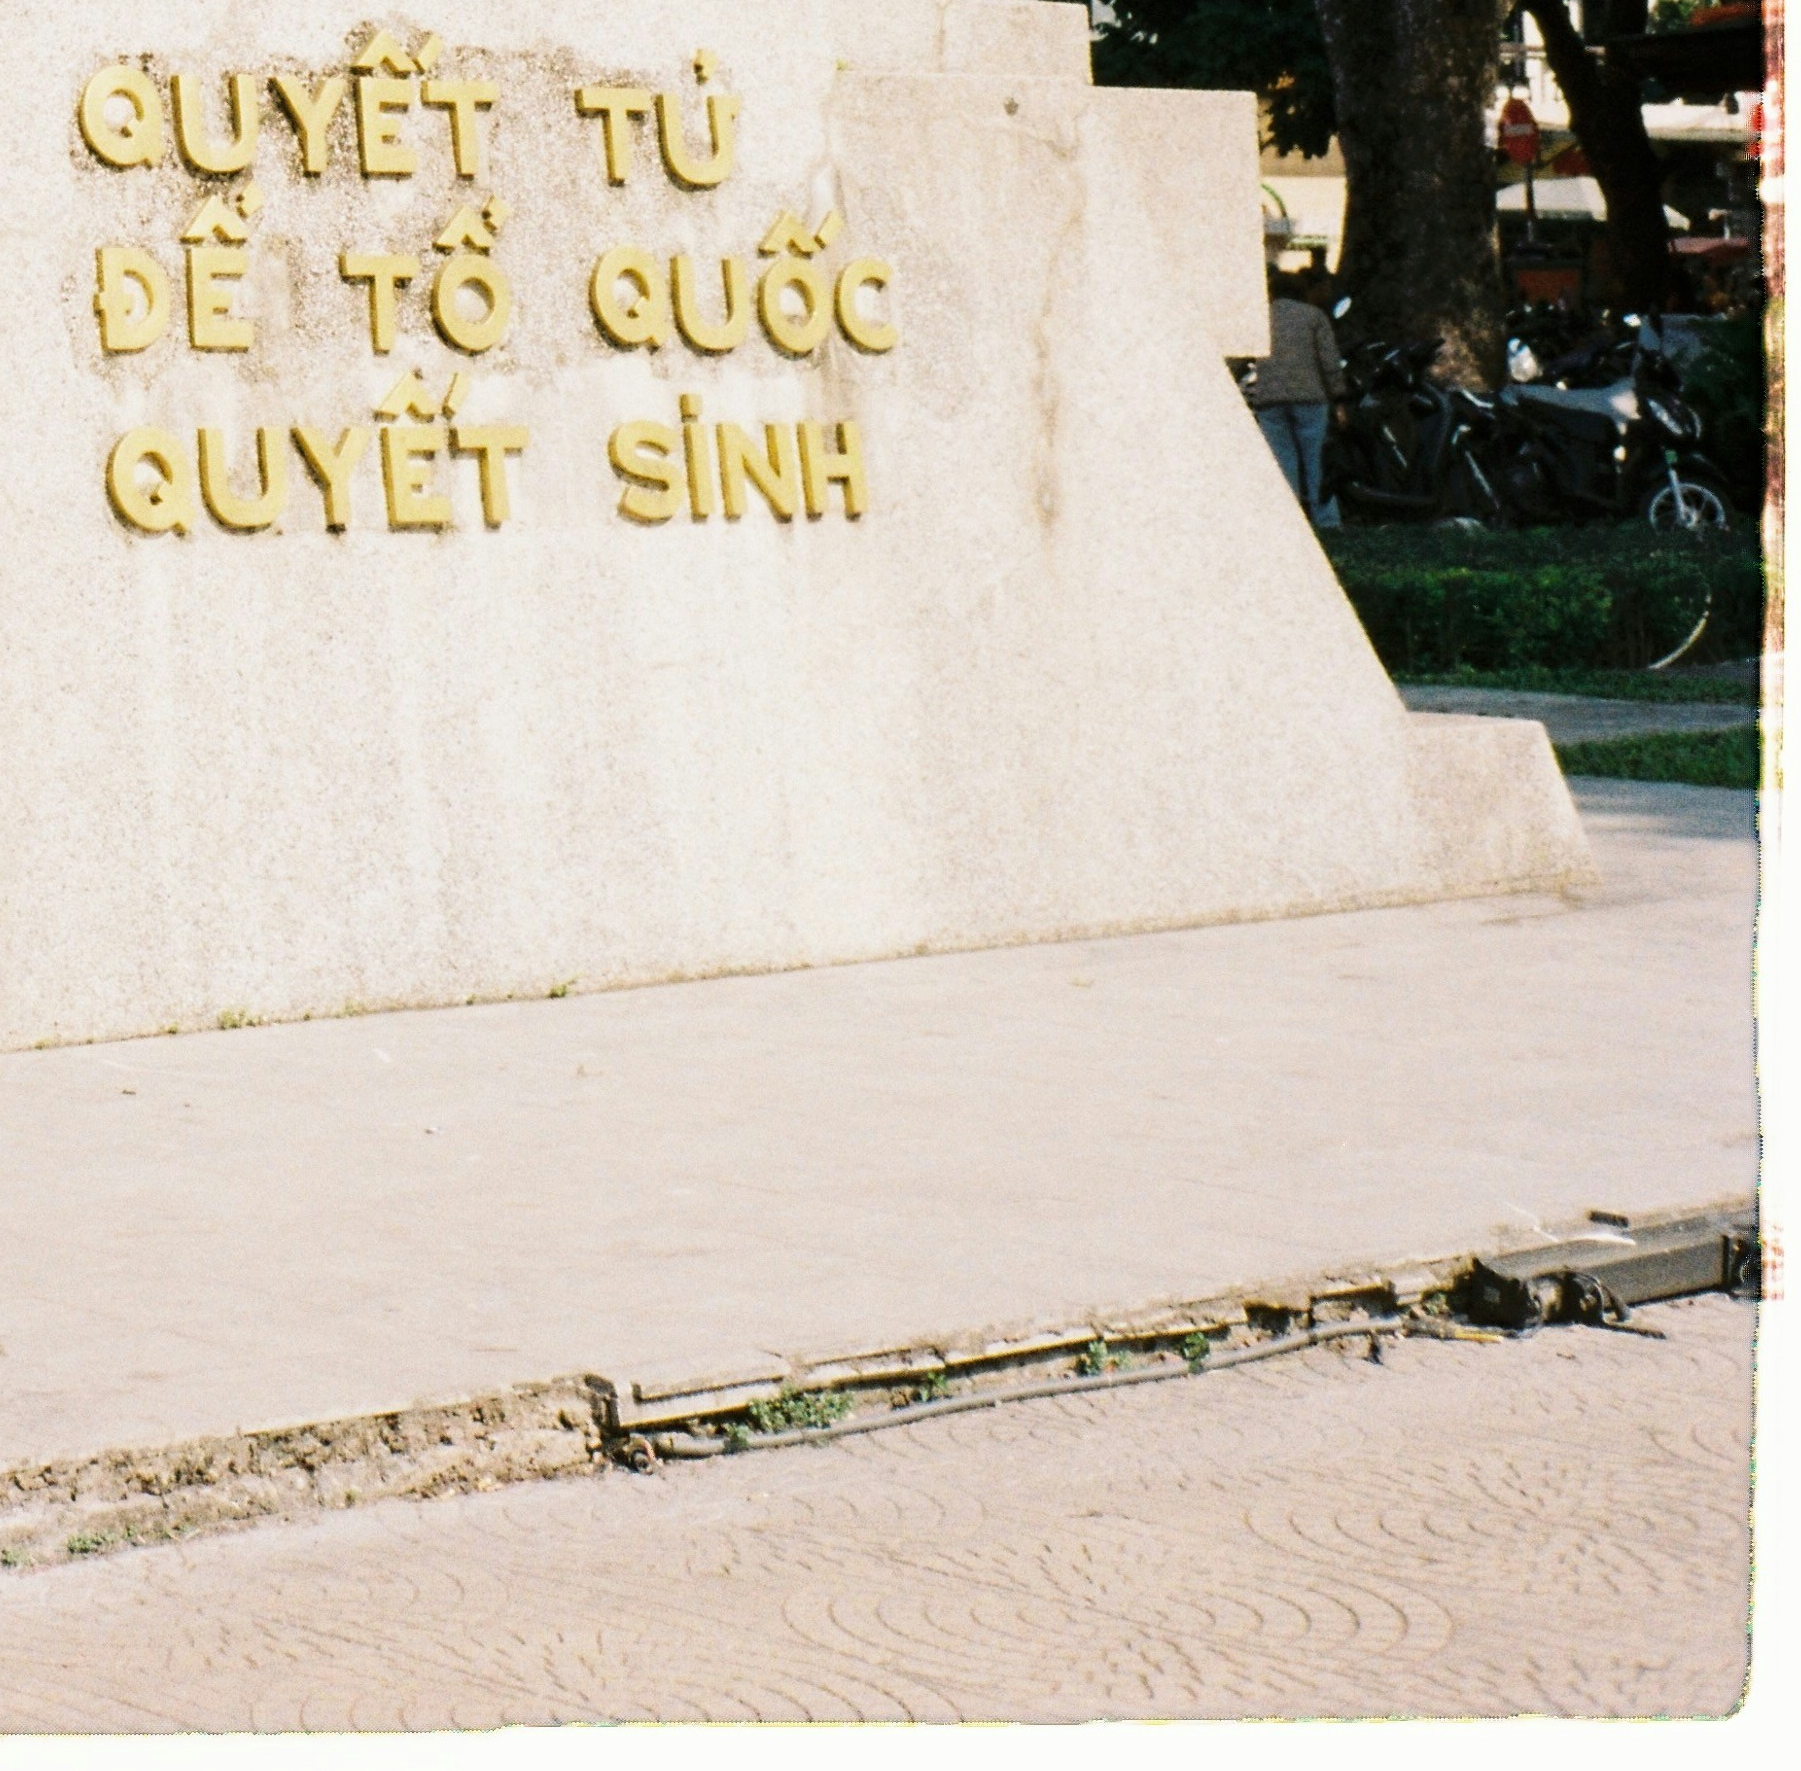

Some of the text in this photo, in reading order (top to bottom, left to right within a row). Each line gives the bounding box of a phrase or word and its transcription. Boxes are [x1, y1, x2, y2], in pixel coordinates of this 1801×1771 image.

[77, 29, 741, 191] QUYẾT TỬ
[338, 194, 512, 356] TỔ
[588, 208, 898, 356] QUỐC
[105, 371, 530, 537] QUYẾT
